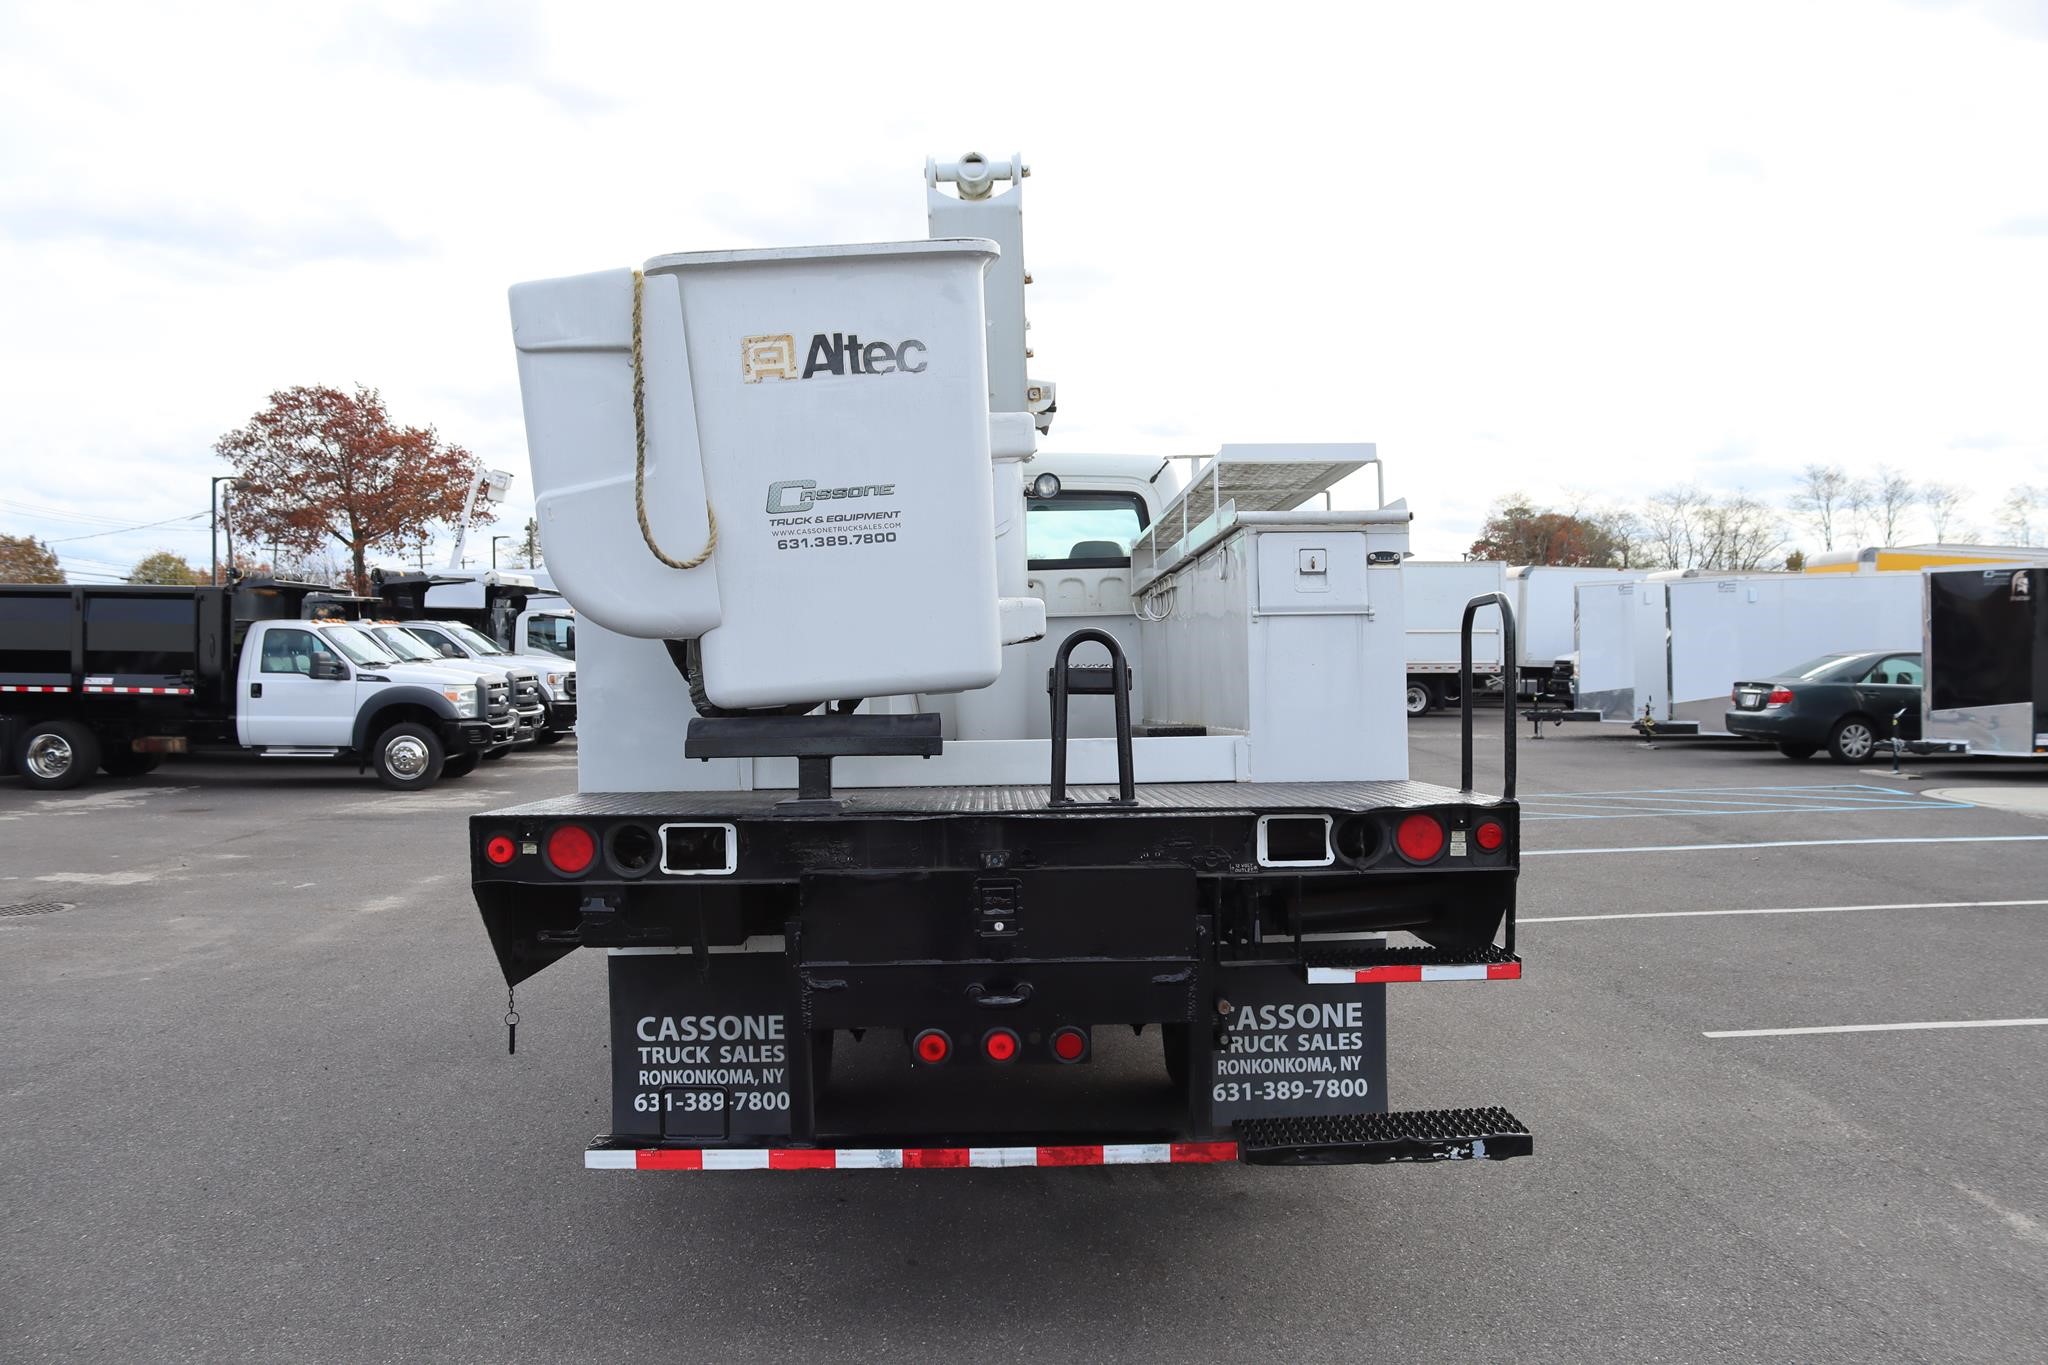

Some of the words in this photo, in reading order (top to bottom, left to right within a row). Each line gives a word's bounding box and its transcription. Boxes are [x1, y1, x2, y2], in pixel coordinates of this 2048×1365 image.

[802, 332, 928, 379] Altec
[769, 516, 813, 527] TRUCK
[815, 515, 825, 524] &
[826, 510, 901, 523] EQUIPMENT
[771, 522, 902, 536] WWW.CASSONETRUCKSALES.COM
[777, 531, 897, 550] 631.389.7800
[1227, 1002, 1363, 1031] ASSONE
[636, 1015, 785, 1042] CASSONE
[1220, 1034, 1289, 1054] RUCK
[1297, 1031, 1363, 1052] SALES
[637, 1045, 711, 1064] TRUCK
[719, 1044, 785, 1063] SALES
[1217, 1056, 1337, 1075] RONKONKOMA,
[1340, 1055, 1362, 1072] NY
[639, 1068, 759, 1087] RONKONKOMA,
[762, 1067, 785, 1084] NY
[1212, 1078, 1368, 1102] 631-389-7800
[633, 1090, 790, 1112] 631-389-7800
